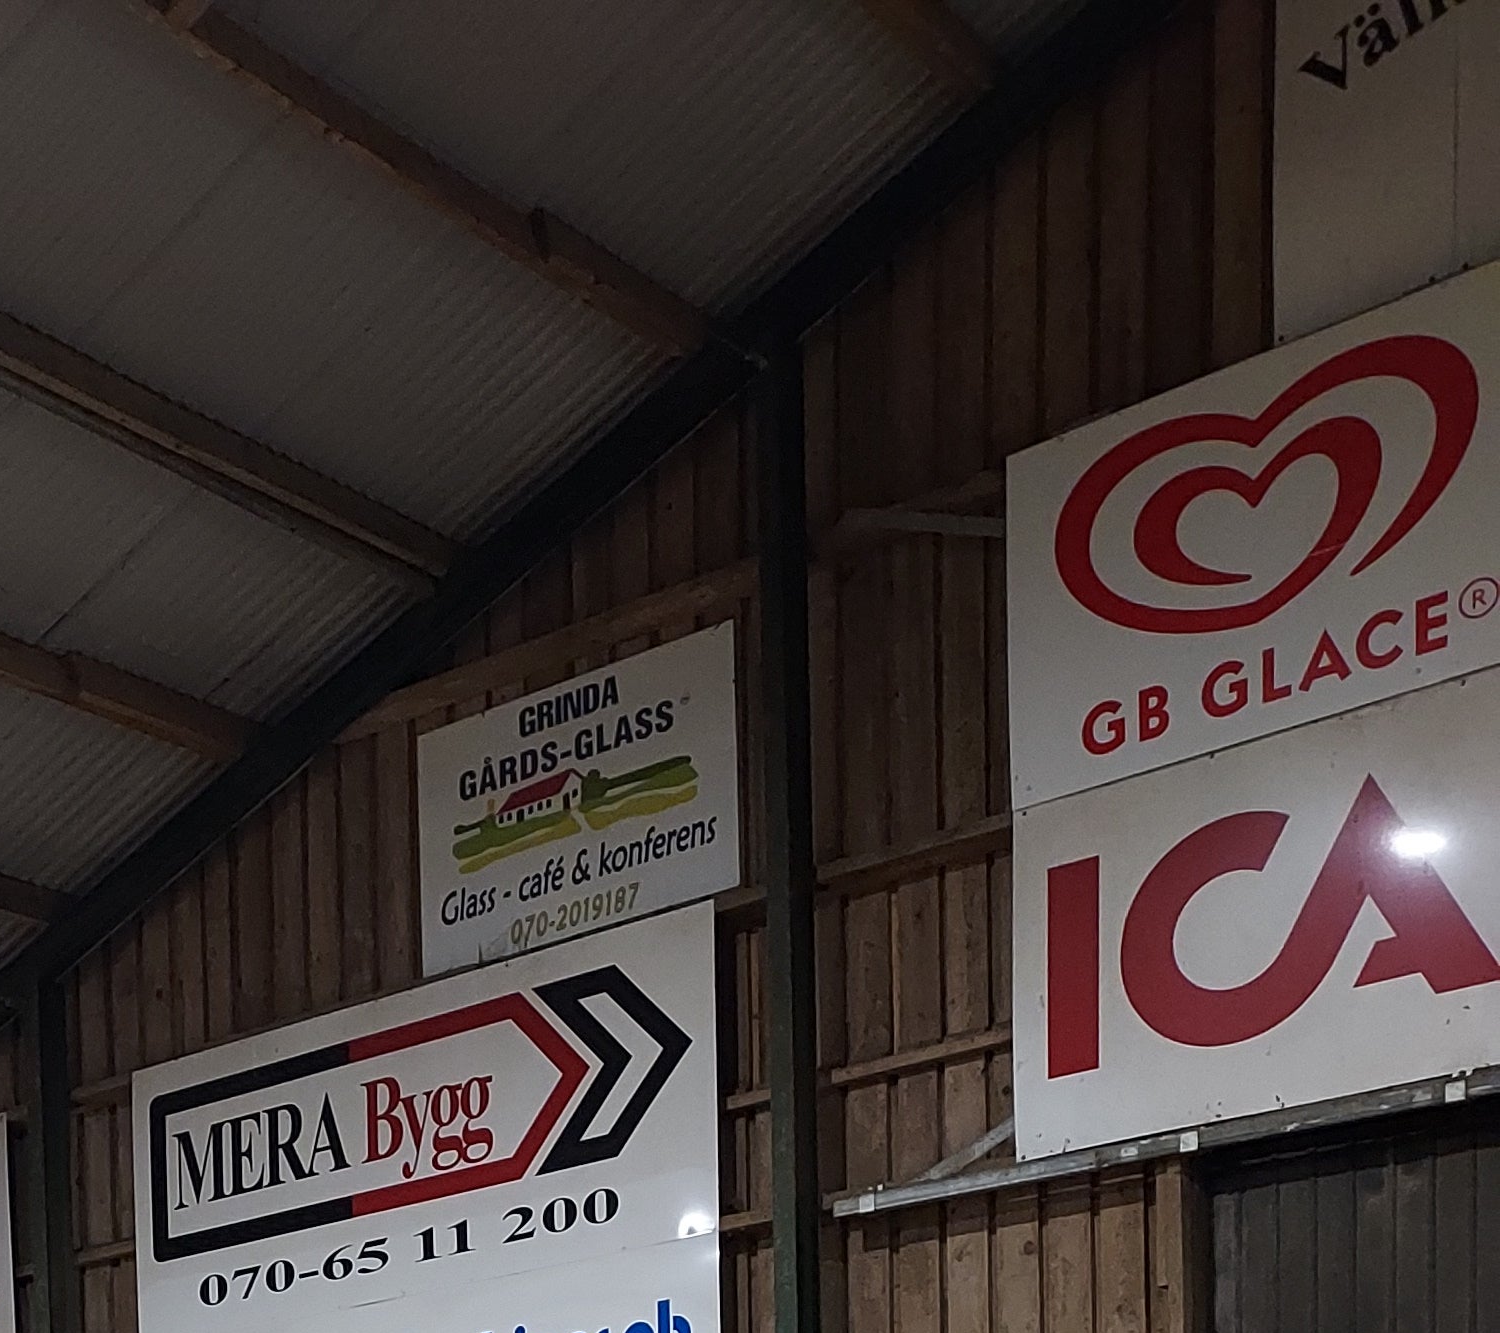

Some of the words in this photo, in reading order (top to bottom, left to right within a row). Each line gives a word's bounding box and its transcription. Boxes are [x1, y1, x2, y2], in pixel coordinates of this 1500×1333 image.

[459, 700, 674, 801] GÅRDS-GLASS
[518, 675, 619, 738] GRINDA
[1081, 685, 1171, 756] GB
[441, 886, 496, 926] Glass
[518, 856, 564, 902] café
[571, 848, 591, 885] &
[598, 816, 717, 878] konferens
[509, 882, 640, 948] 070-2019187
[1047, 772, 1500, 1080] ICA
[172, 1091, 350, 1211] MERA
[361, 1075, 494, 1180] Bygg
[199, 1237, 389, 1306] 070-65
[414, 1219, 476, 1263] 11
[502, 1187, 619, 1245] 200
